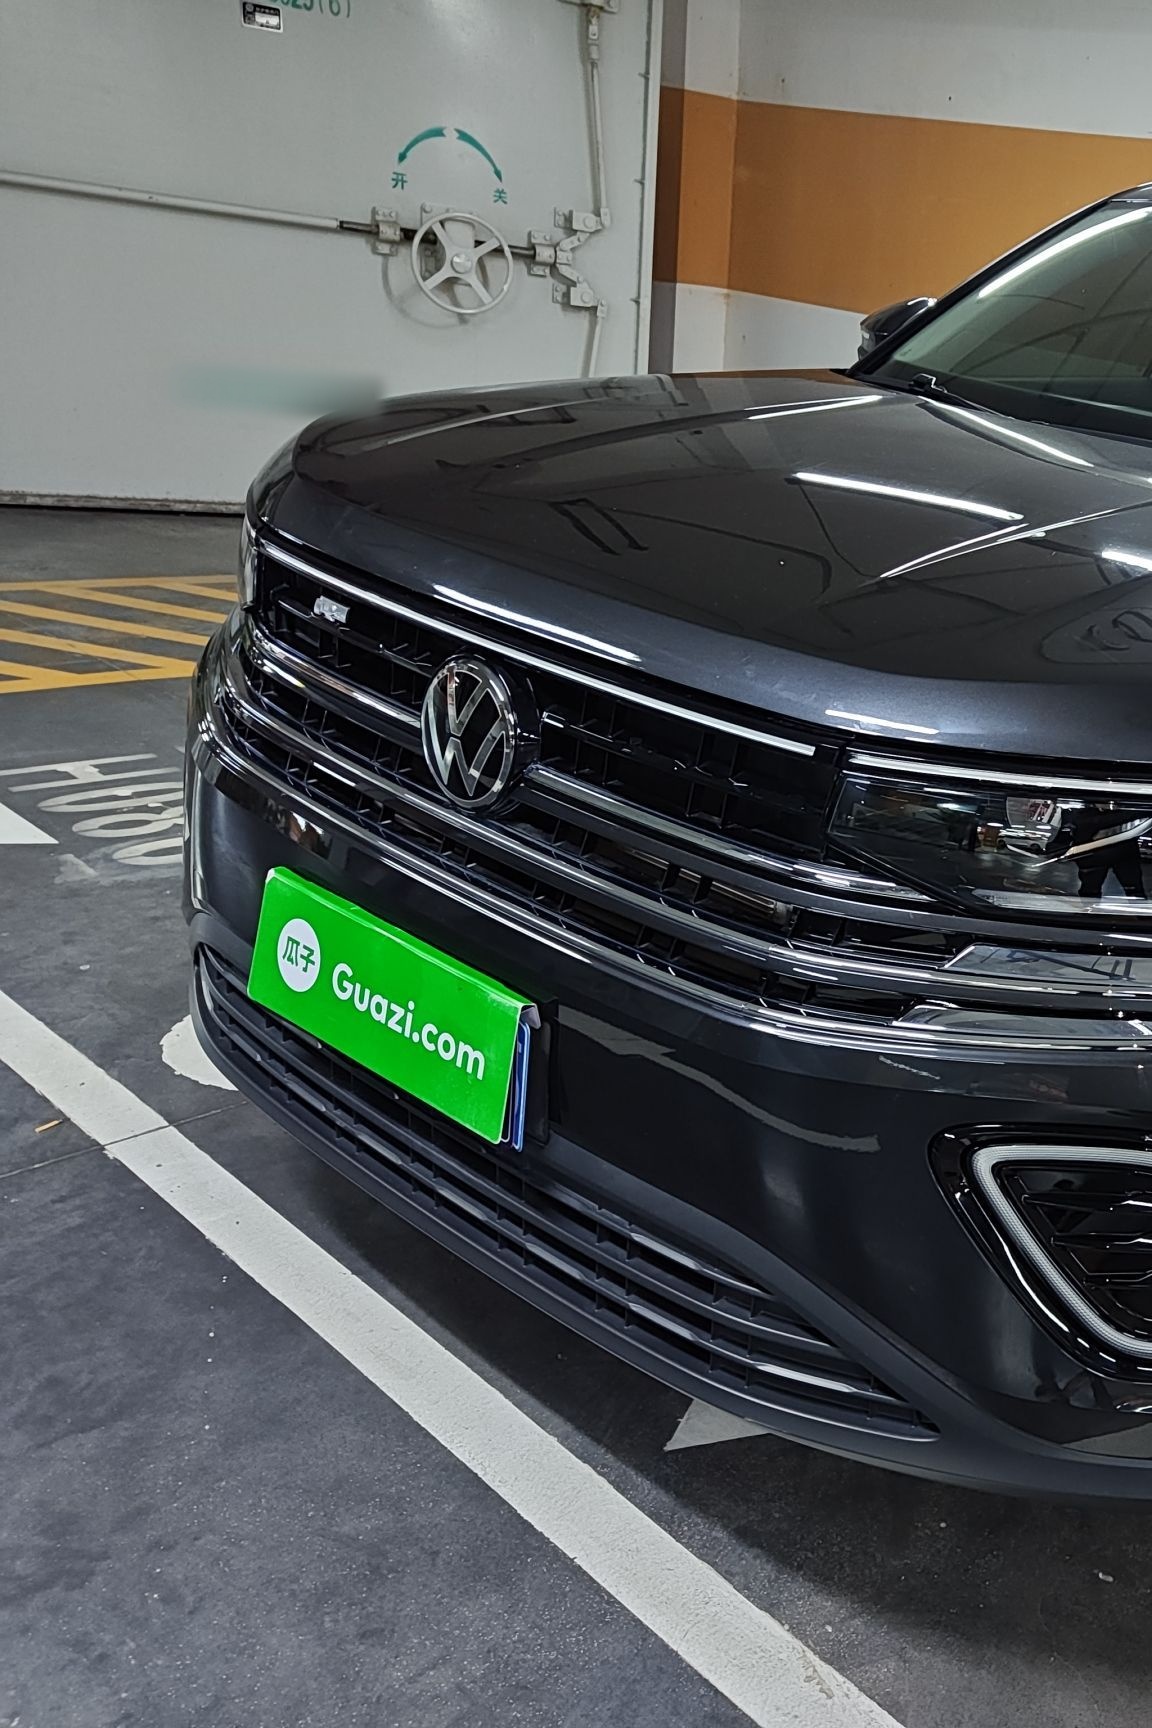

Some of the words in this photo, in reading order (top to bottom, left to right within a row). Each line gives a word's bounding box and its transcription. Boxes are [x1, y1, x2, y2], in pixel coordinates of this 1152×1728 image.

[391, 171, 408, 190] 开
[493, 188, 508, 205] 关
[282, 935, 316, 973] 瓜子
[332, 962, 486, 1081] Guazi.com
